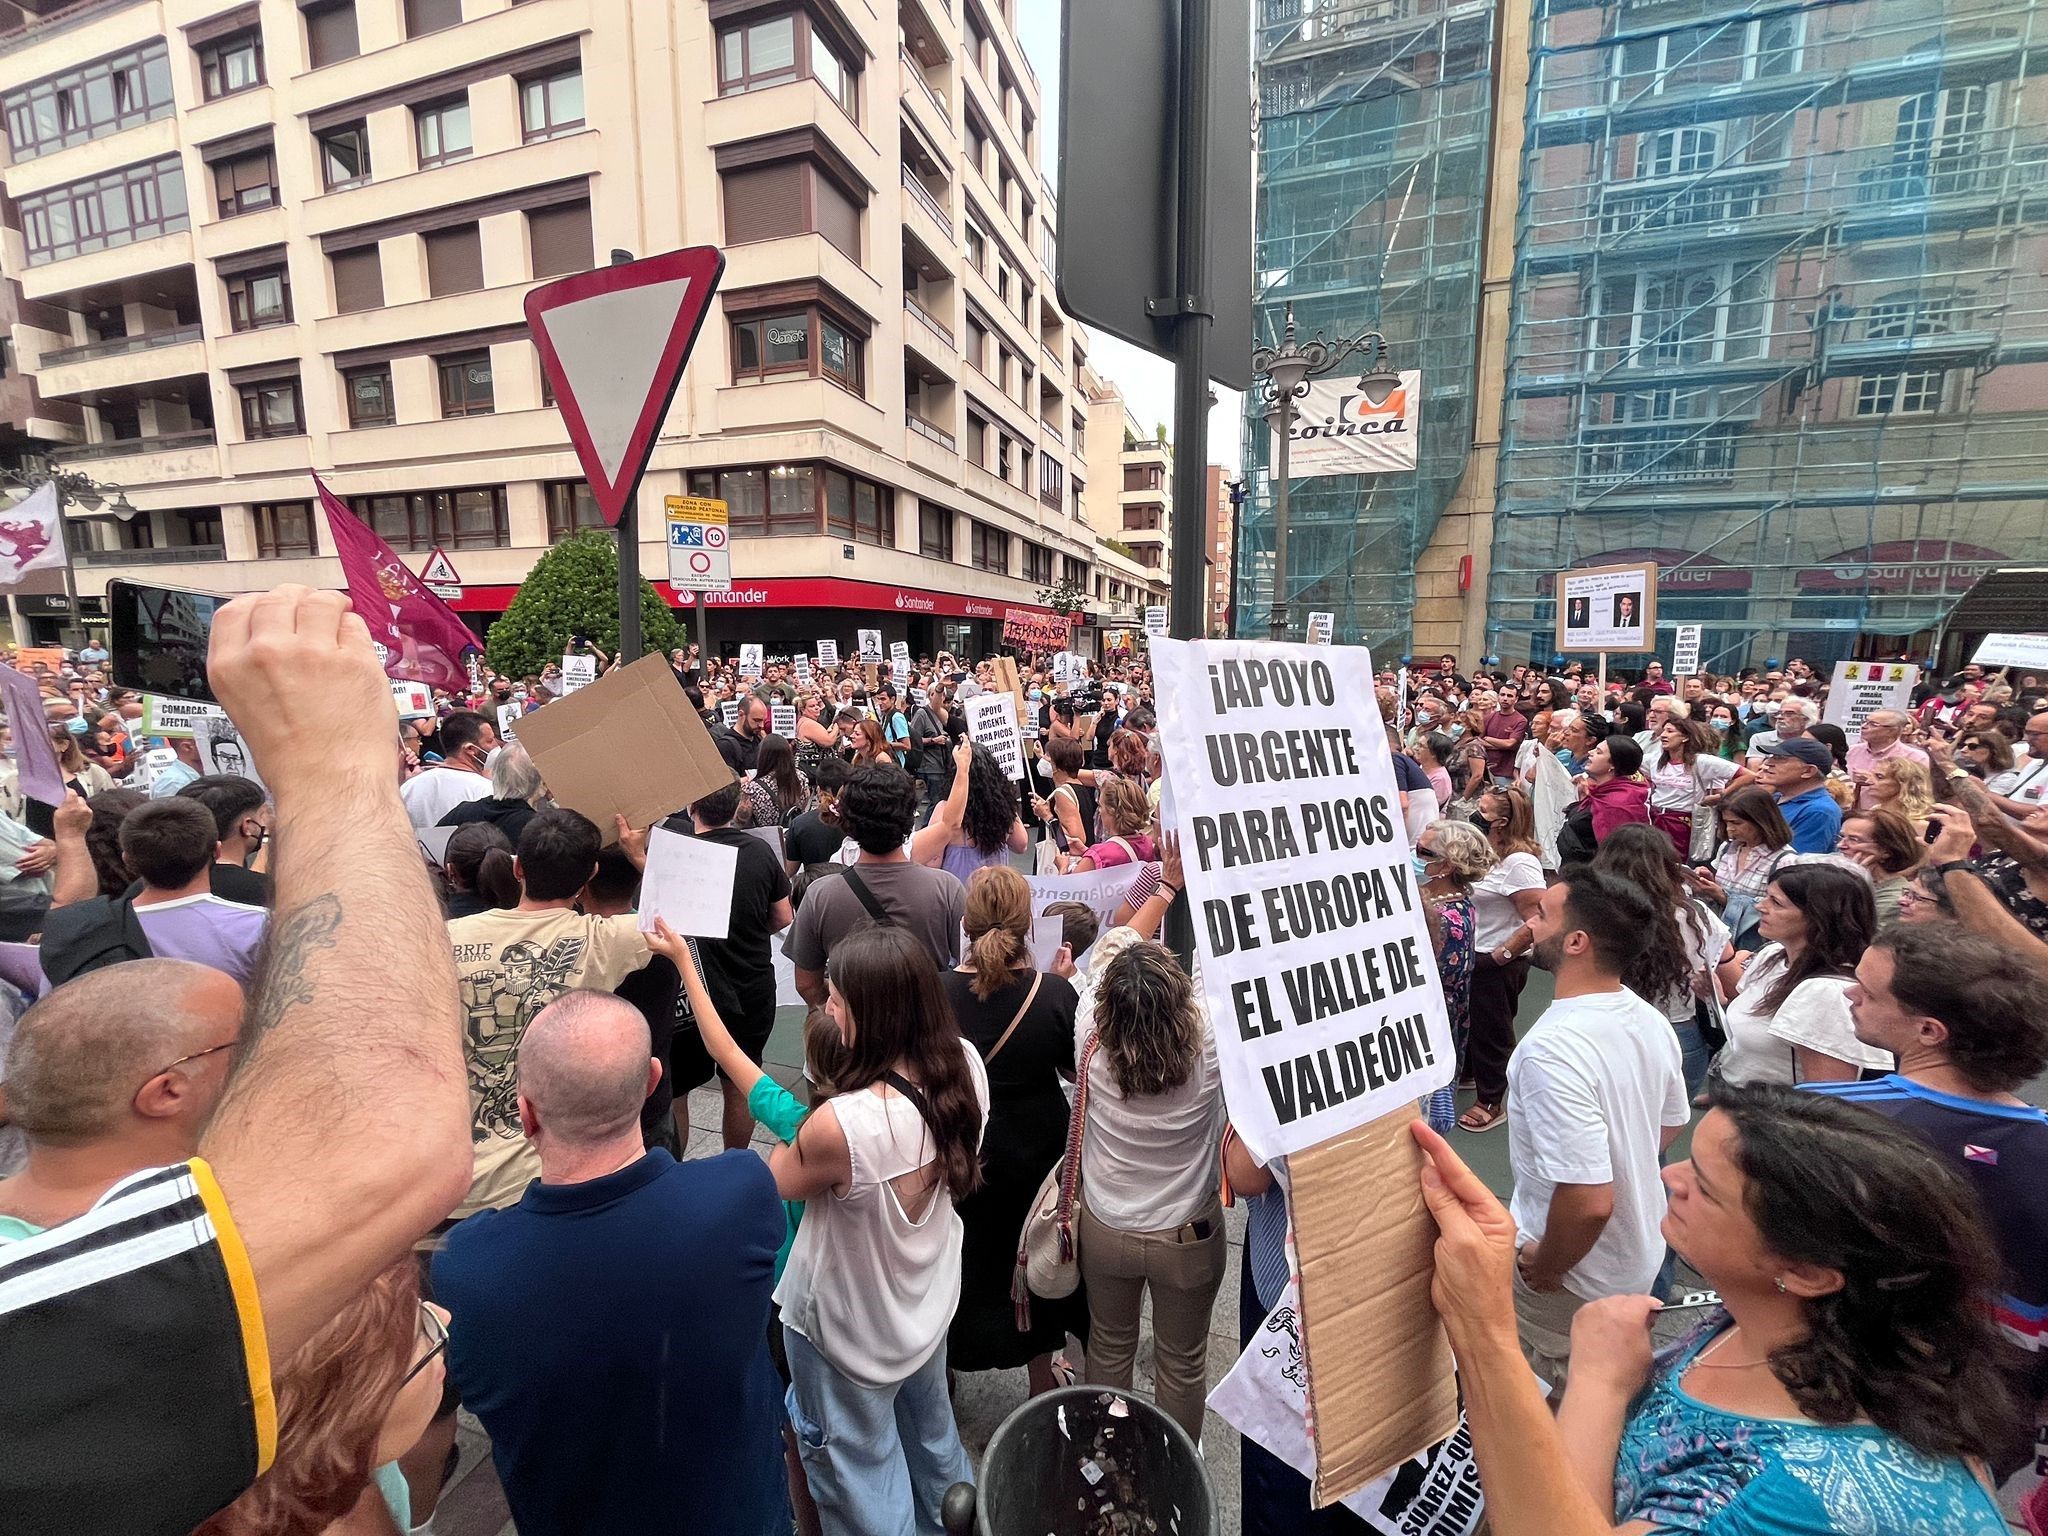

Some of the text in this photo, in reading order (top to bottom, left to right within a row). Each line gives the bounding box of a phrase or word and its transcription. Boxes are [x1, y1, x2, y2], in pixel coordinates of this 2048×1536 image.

[767, 328, 804, 344] Qanat
[710, 533, 720, 541] 10
[704, 587, 768, 603] antander
[904, 595, 935, 611] Santander
[971, 603, 993, 615] Santander
[766, 655, 790, 663] Work
[1209, 658, 1335, 715] ¡APOYO
[162, 704, 208, 715] COMARCAS
[978, 704, 1002, 718] ¡APOYO
[160, 717, 192, 728] AFECTA
[977, 716, 1007, 730] URGENTE
[976, 727, 1013, 744] PARA PICOS
[1011, 739, 1016, 748] Y
[1008, 752, 1016, 761] DE
[1205, 728, 1360, 786] URGENTE
[1192, 794, 1394, 872] PARA PICOS
[1203, 863, 1412, 958] DE EUROPA Y
[452, 943, 493, 957] BRIF
[453, 954, 492, 963] ABUYO
[1231, 936, 1426, 1042] EL VALLE DE
[1260, 1013, 1435, 1126] VALDEÓN!
